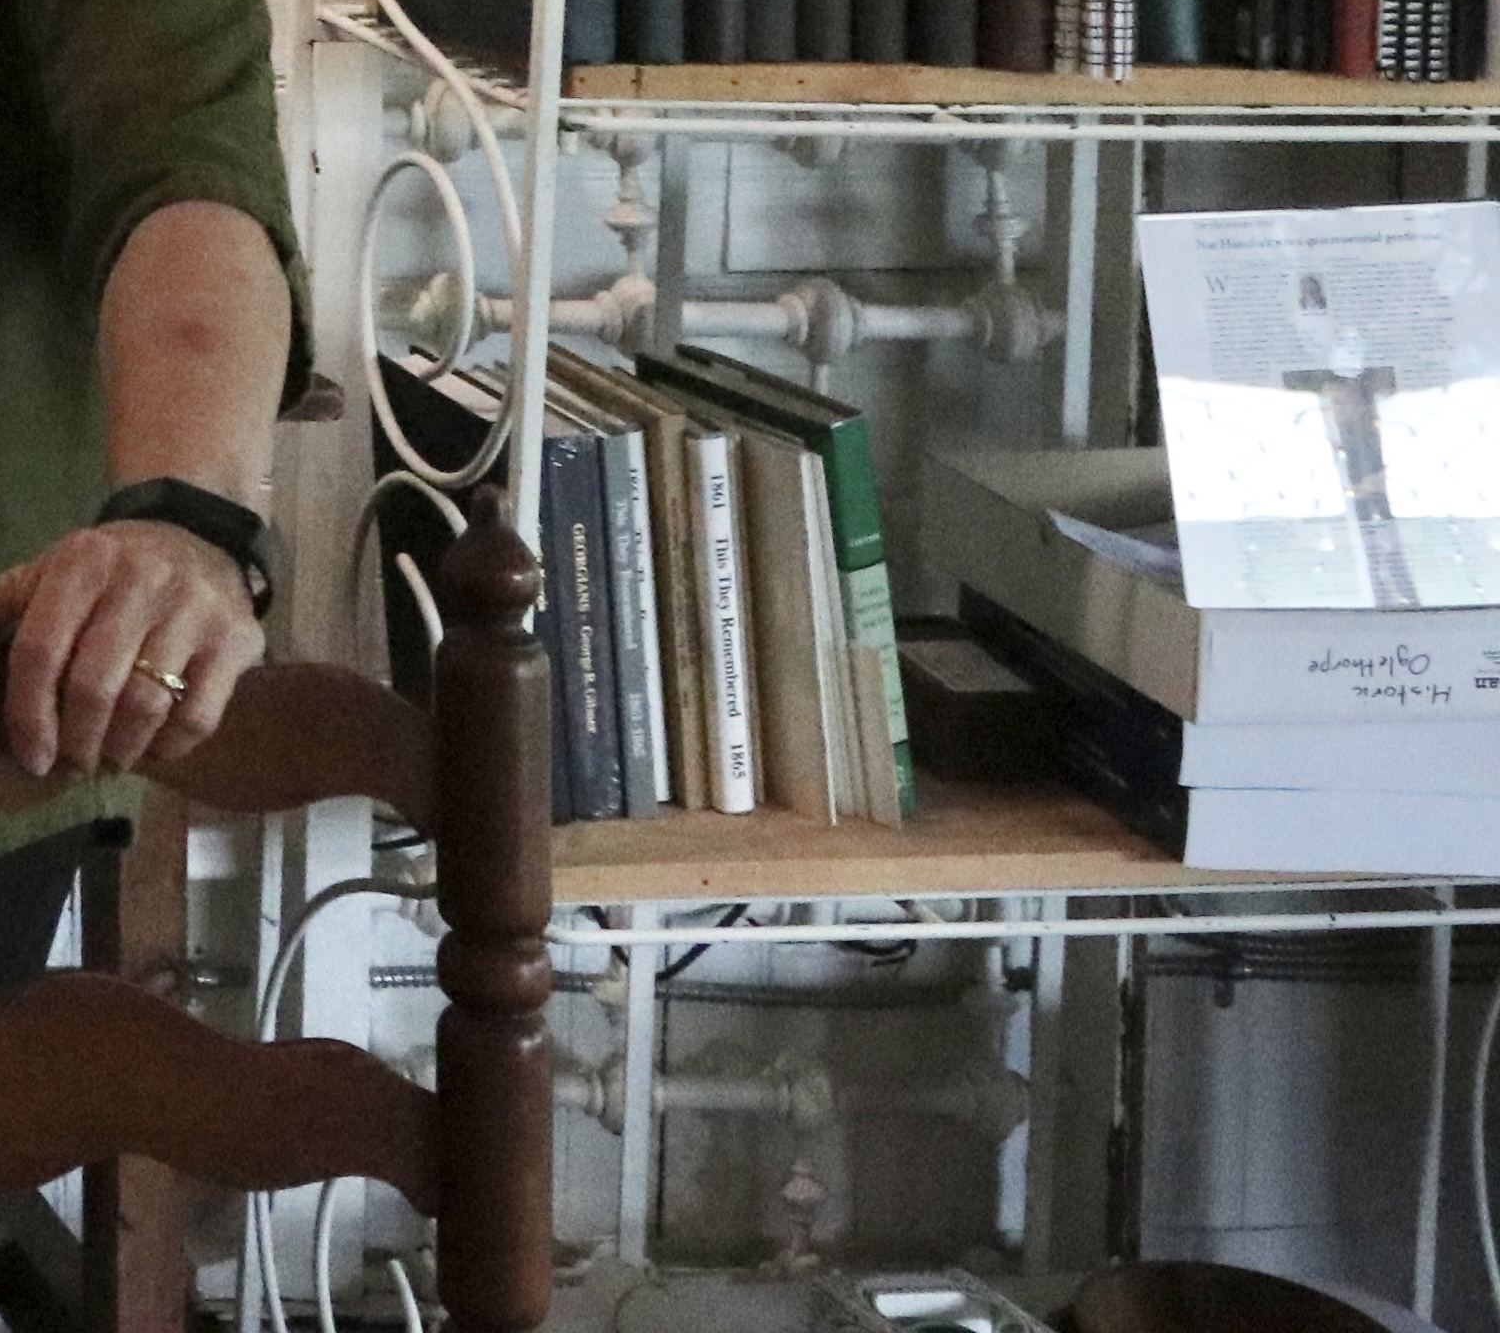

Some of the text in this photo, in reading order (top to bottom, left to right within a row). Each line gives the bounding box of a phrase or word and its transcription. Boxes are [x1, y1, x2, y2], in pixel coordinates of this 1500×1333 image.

[572, 523, 591, 613] GEORGIANS
[710, 474, 747, 780] 1861 This They Remembered 1865
[1308, 643, 1430, 677] Oglethorpe
